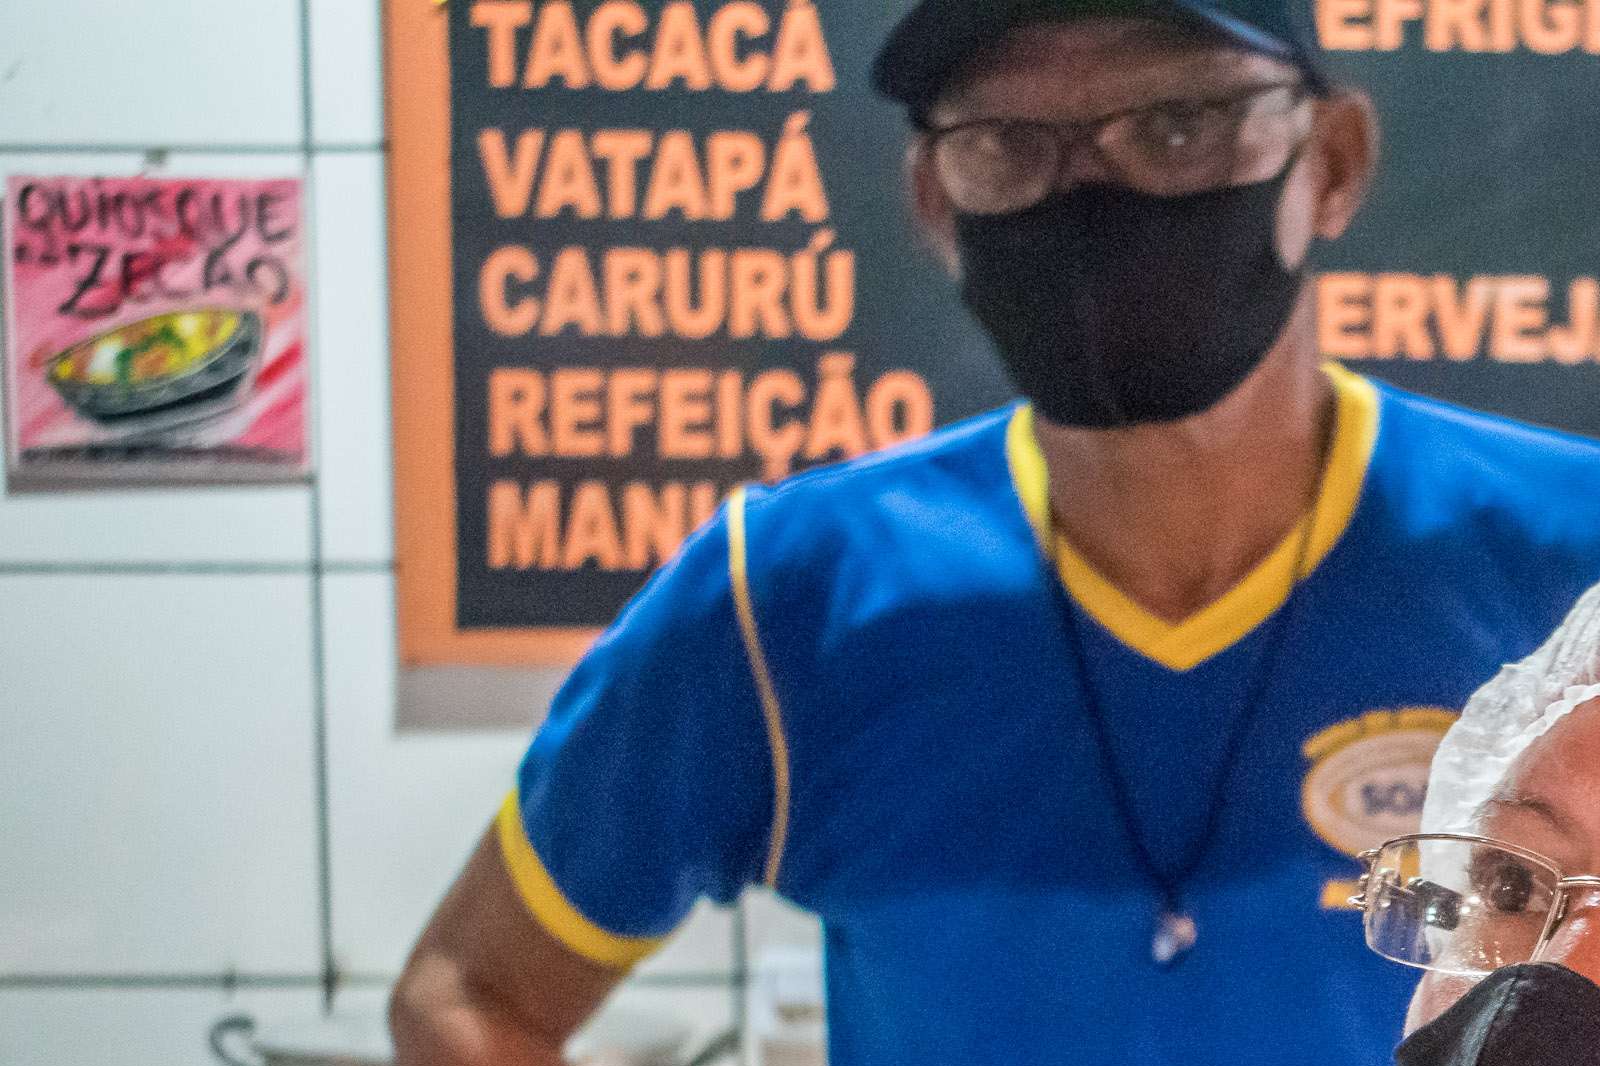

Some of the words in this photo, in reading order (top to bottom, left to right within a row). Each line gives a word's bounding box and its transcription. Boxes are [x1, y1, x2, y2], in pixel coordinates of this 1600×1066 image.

[471, 0, 833, 91] TACACÁ
[480, 113, 827, 222] VATAPÁ
[481, 230, 853, 340] CARURÚ
[490, 354, 932, 478] REFEIÇÃO
[489, 482, 714, 569] MANI
